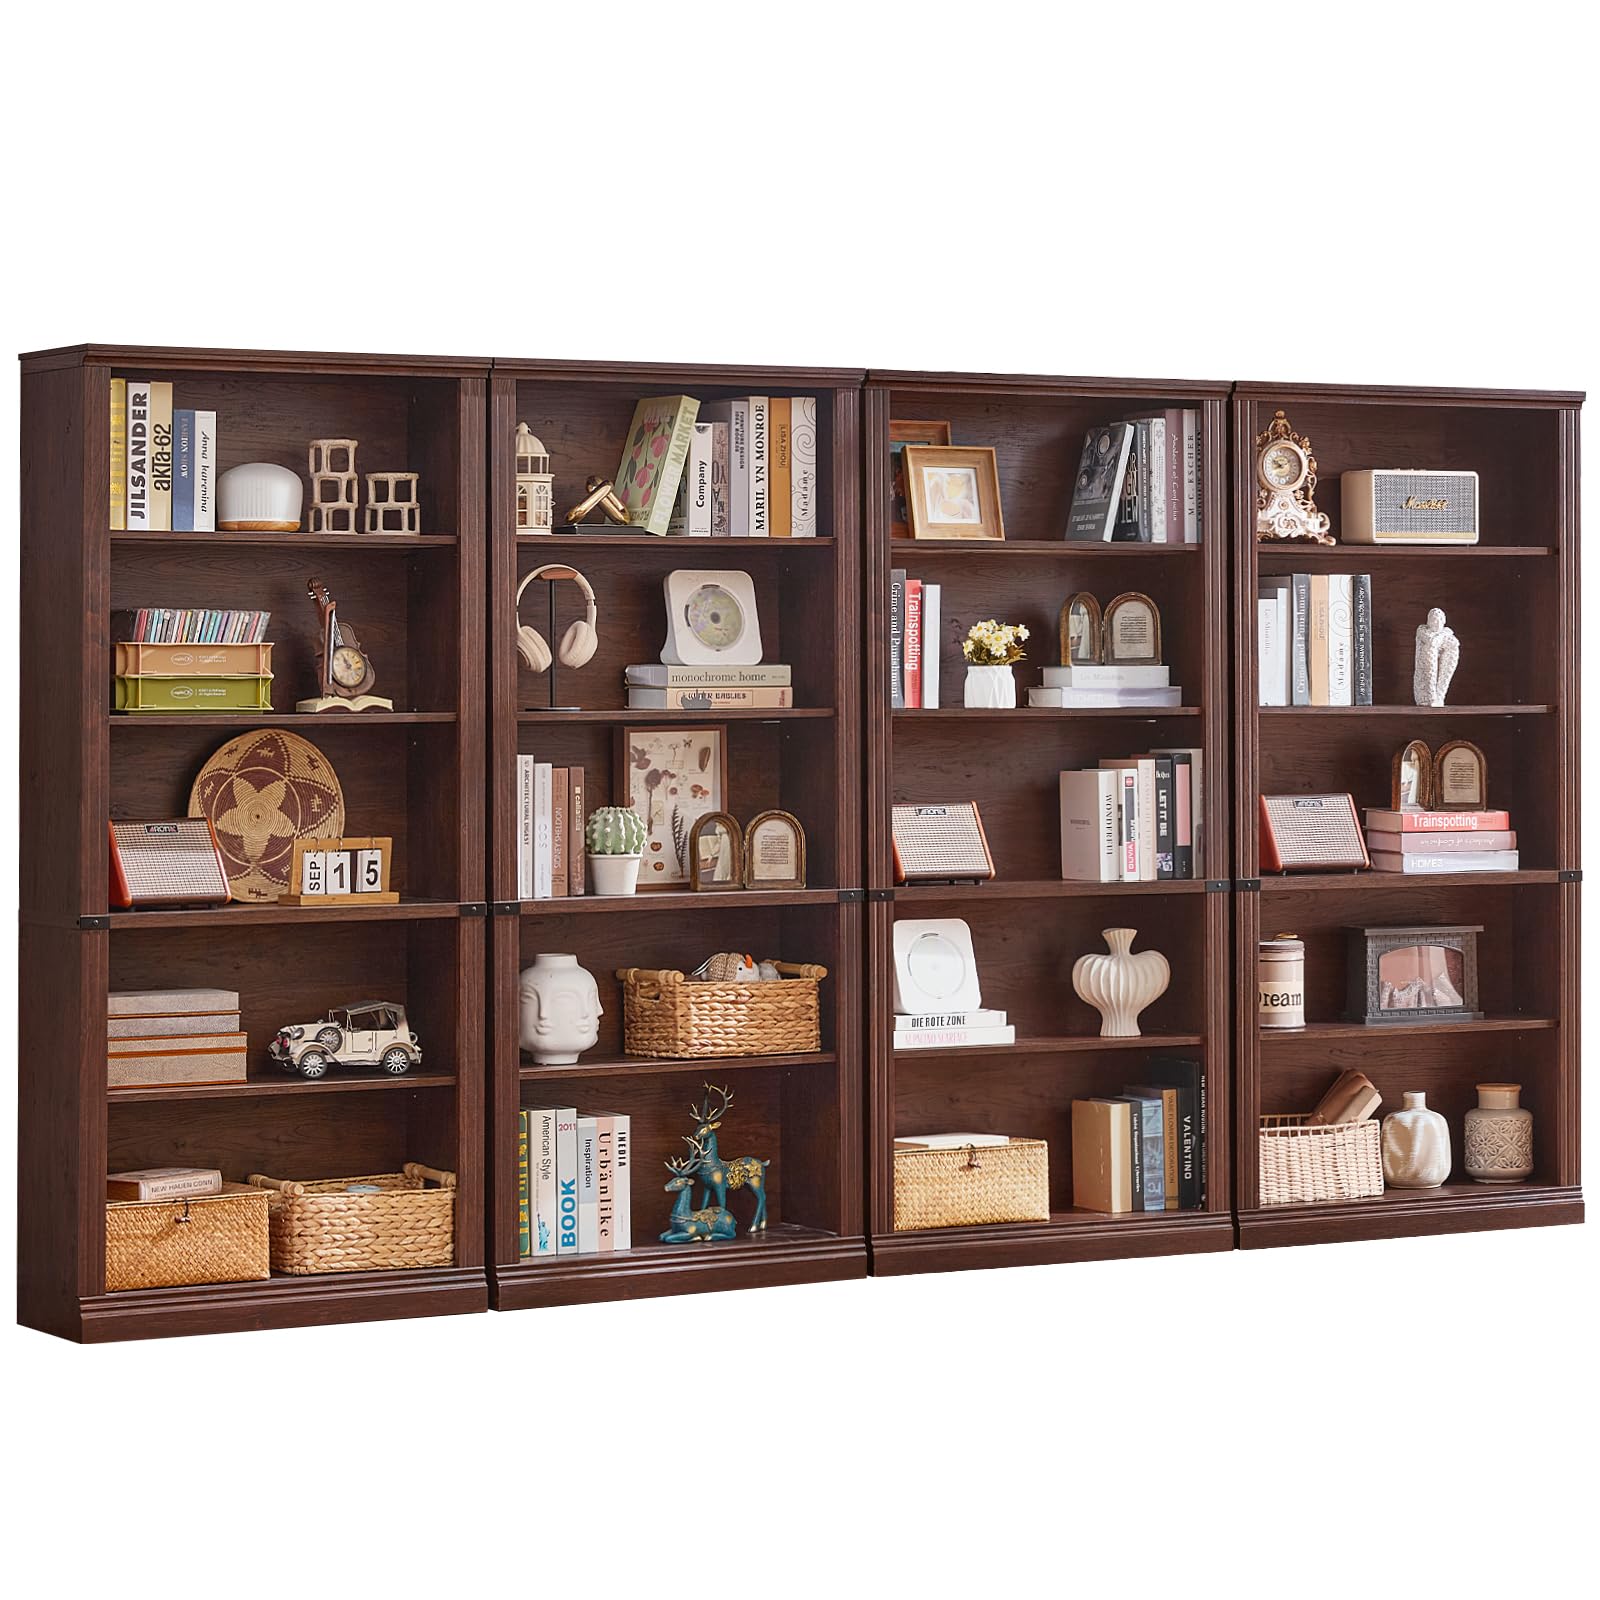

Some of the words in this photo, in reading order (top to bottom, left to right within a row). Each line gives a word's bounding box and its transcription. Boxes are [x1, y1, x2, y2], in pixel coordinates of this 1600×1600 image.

[180, 416, 189, 452] FASHION
[201, 431, 211, 459] Anna
[671, 406, 696, 463] MARKET
[755, 404, 765, 461] MONROE
[131, 392, 147, 519] JILSANDER
[180, 454, 189, 480] SHOW
[696, 460, 707, 508] Company
[891, 582, 901, 612] Crime
[891, 615, 900, 634] and
[905, 592, 921, 671] Trainspotting
[671, 671, 737, 682] monochrome
[738, 671, 767, 682] home
[891, 637, 900, 698] Punishment
[1159, 789, 1167, 809] LET
[1159, 810, 1167, 821] IT
[1160, 822, 1167, 836] BE
[1412, 814, 1478, 829] Trainspotting
[309, 861, 321, 891] SEP
[333, 862, 345, 888] 1
[365, 860, 379, 886] 5
[911, 1018, 924, 1028] DIE
[925, 1016, 944, 1027] ROTE
[946, 1015, 966, 1026] ZONE
[542, 1115, 551, 1156] American
[558, 1123, 577, 1132] 2011
[1183, 1115, 1192, 1180] VALENTINO
[540, 1158, 551, 1180] Style
[584, 1138, 592, 1189] Inspiration
[561, 1178, 576, 1247] BOOK
